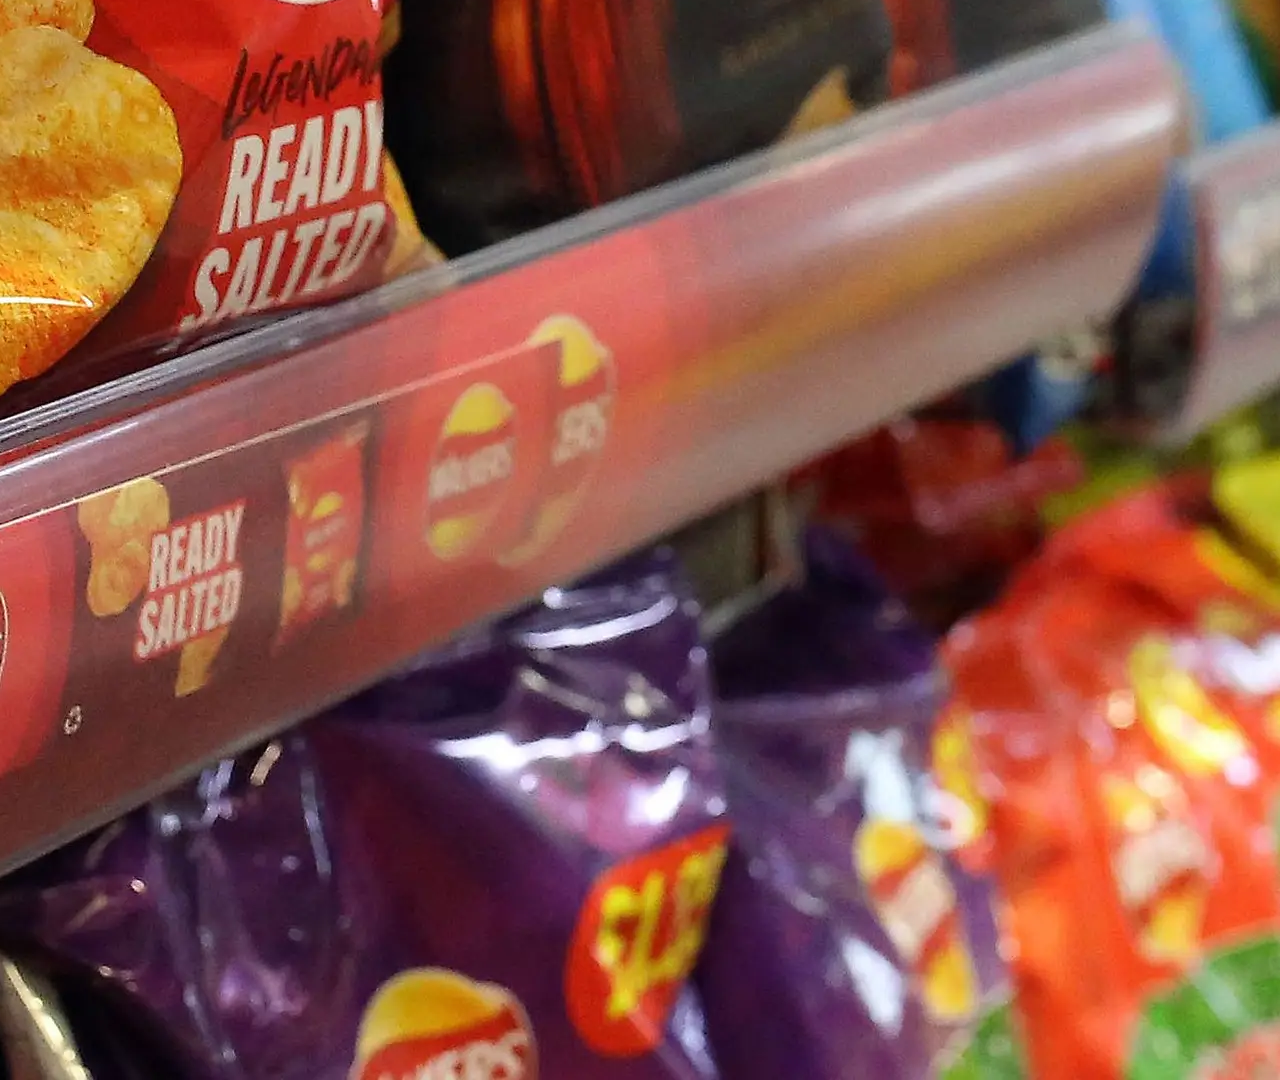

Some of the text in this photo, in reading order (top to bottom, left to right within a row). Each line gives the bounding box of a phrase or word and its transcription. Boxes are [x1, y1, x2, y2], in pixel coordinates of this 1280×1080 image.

[218, 100, 384, 235] READY
[179, 201, 387, 332] SALTED
[149, 505, 246, 593] READY
[136, 568, 243, 658] SALTED
